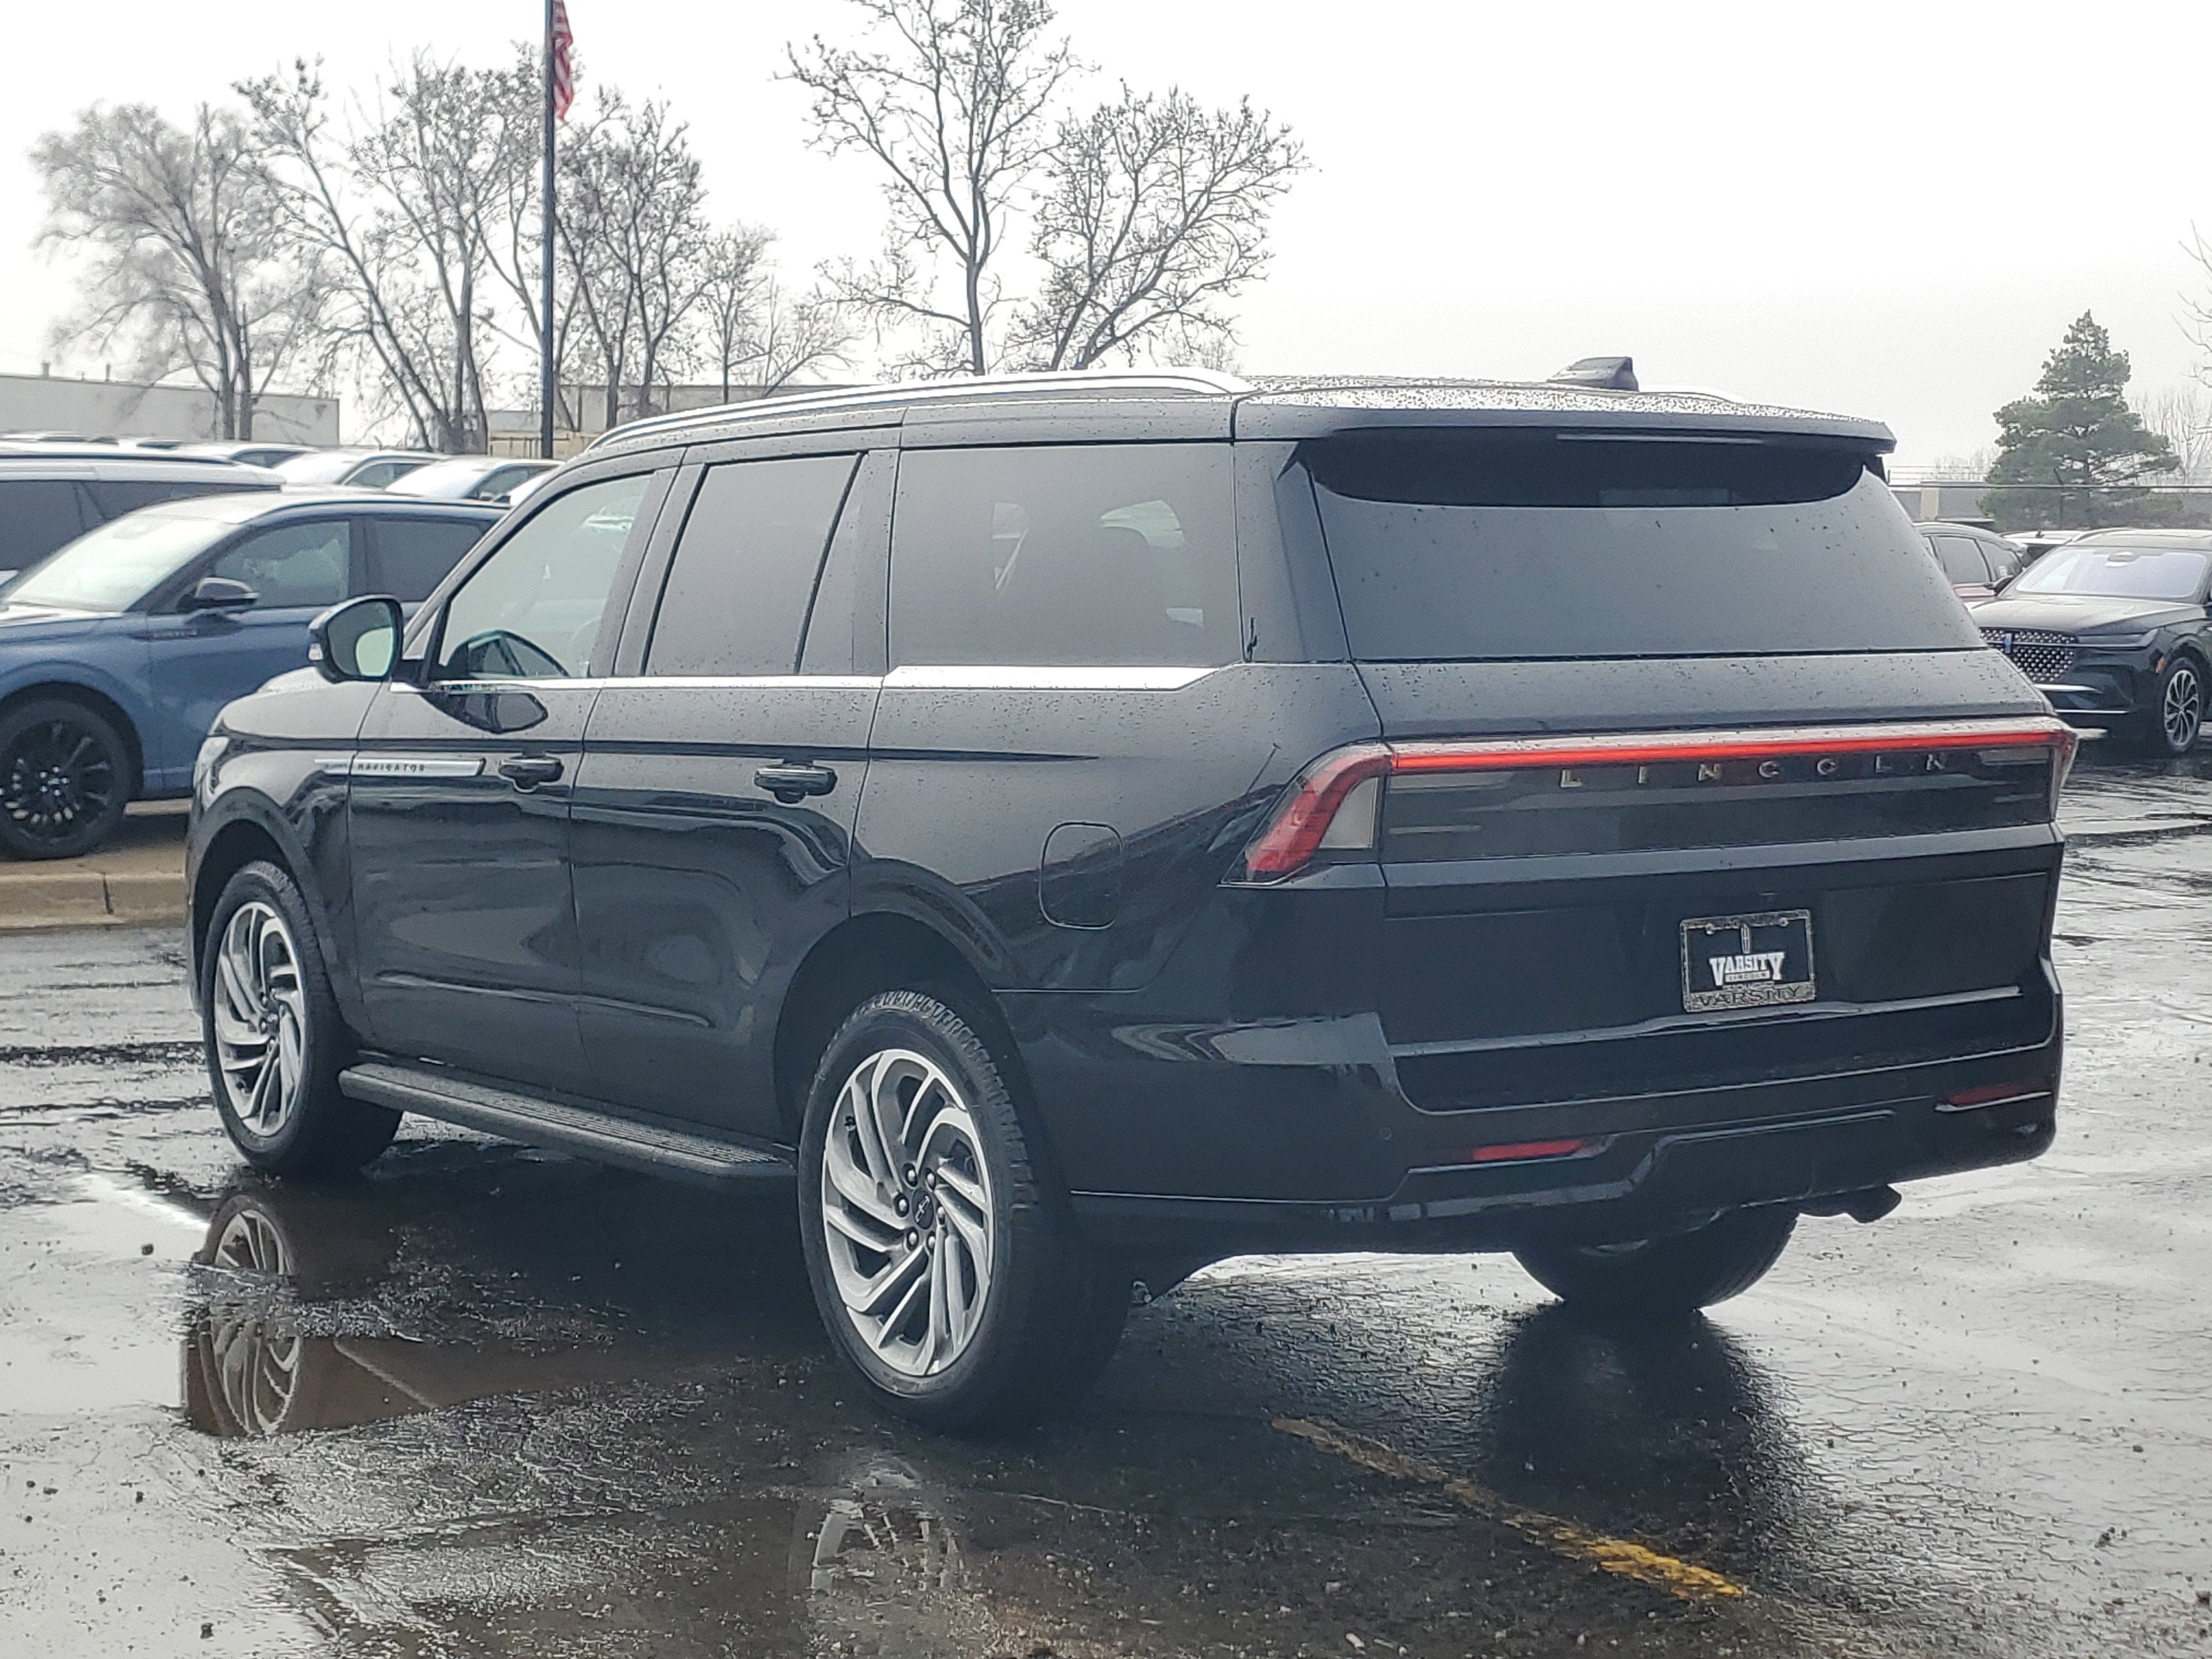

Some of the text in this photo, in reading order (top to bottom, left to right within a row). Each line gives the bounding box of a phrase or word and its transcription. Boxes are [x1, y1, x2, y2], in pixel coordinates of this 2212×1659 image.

[357, 763, 425, 772] NAVIGATOR
[1560, 753, 1946, 788] LINCOLN
[1709, 951, 1785, 986] VARSITY
[1698, 985, 1801, 1006] VARSITY
